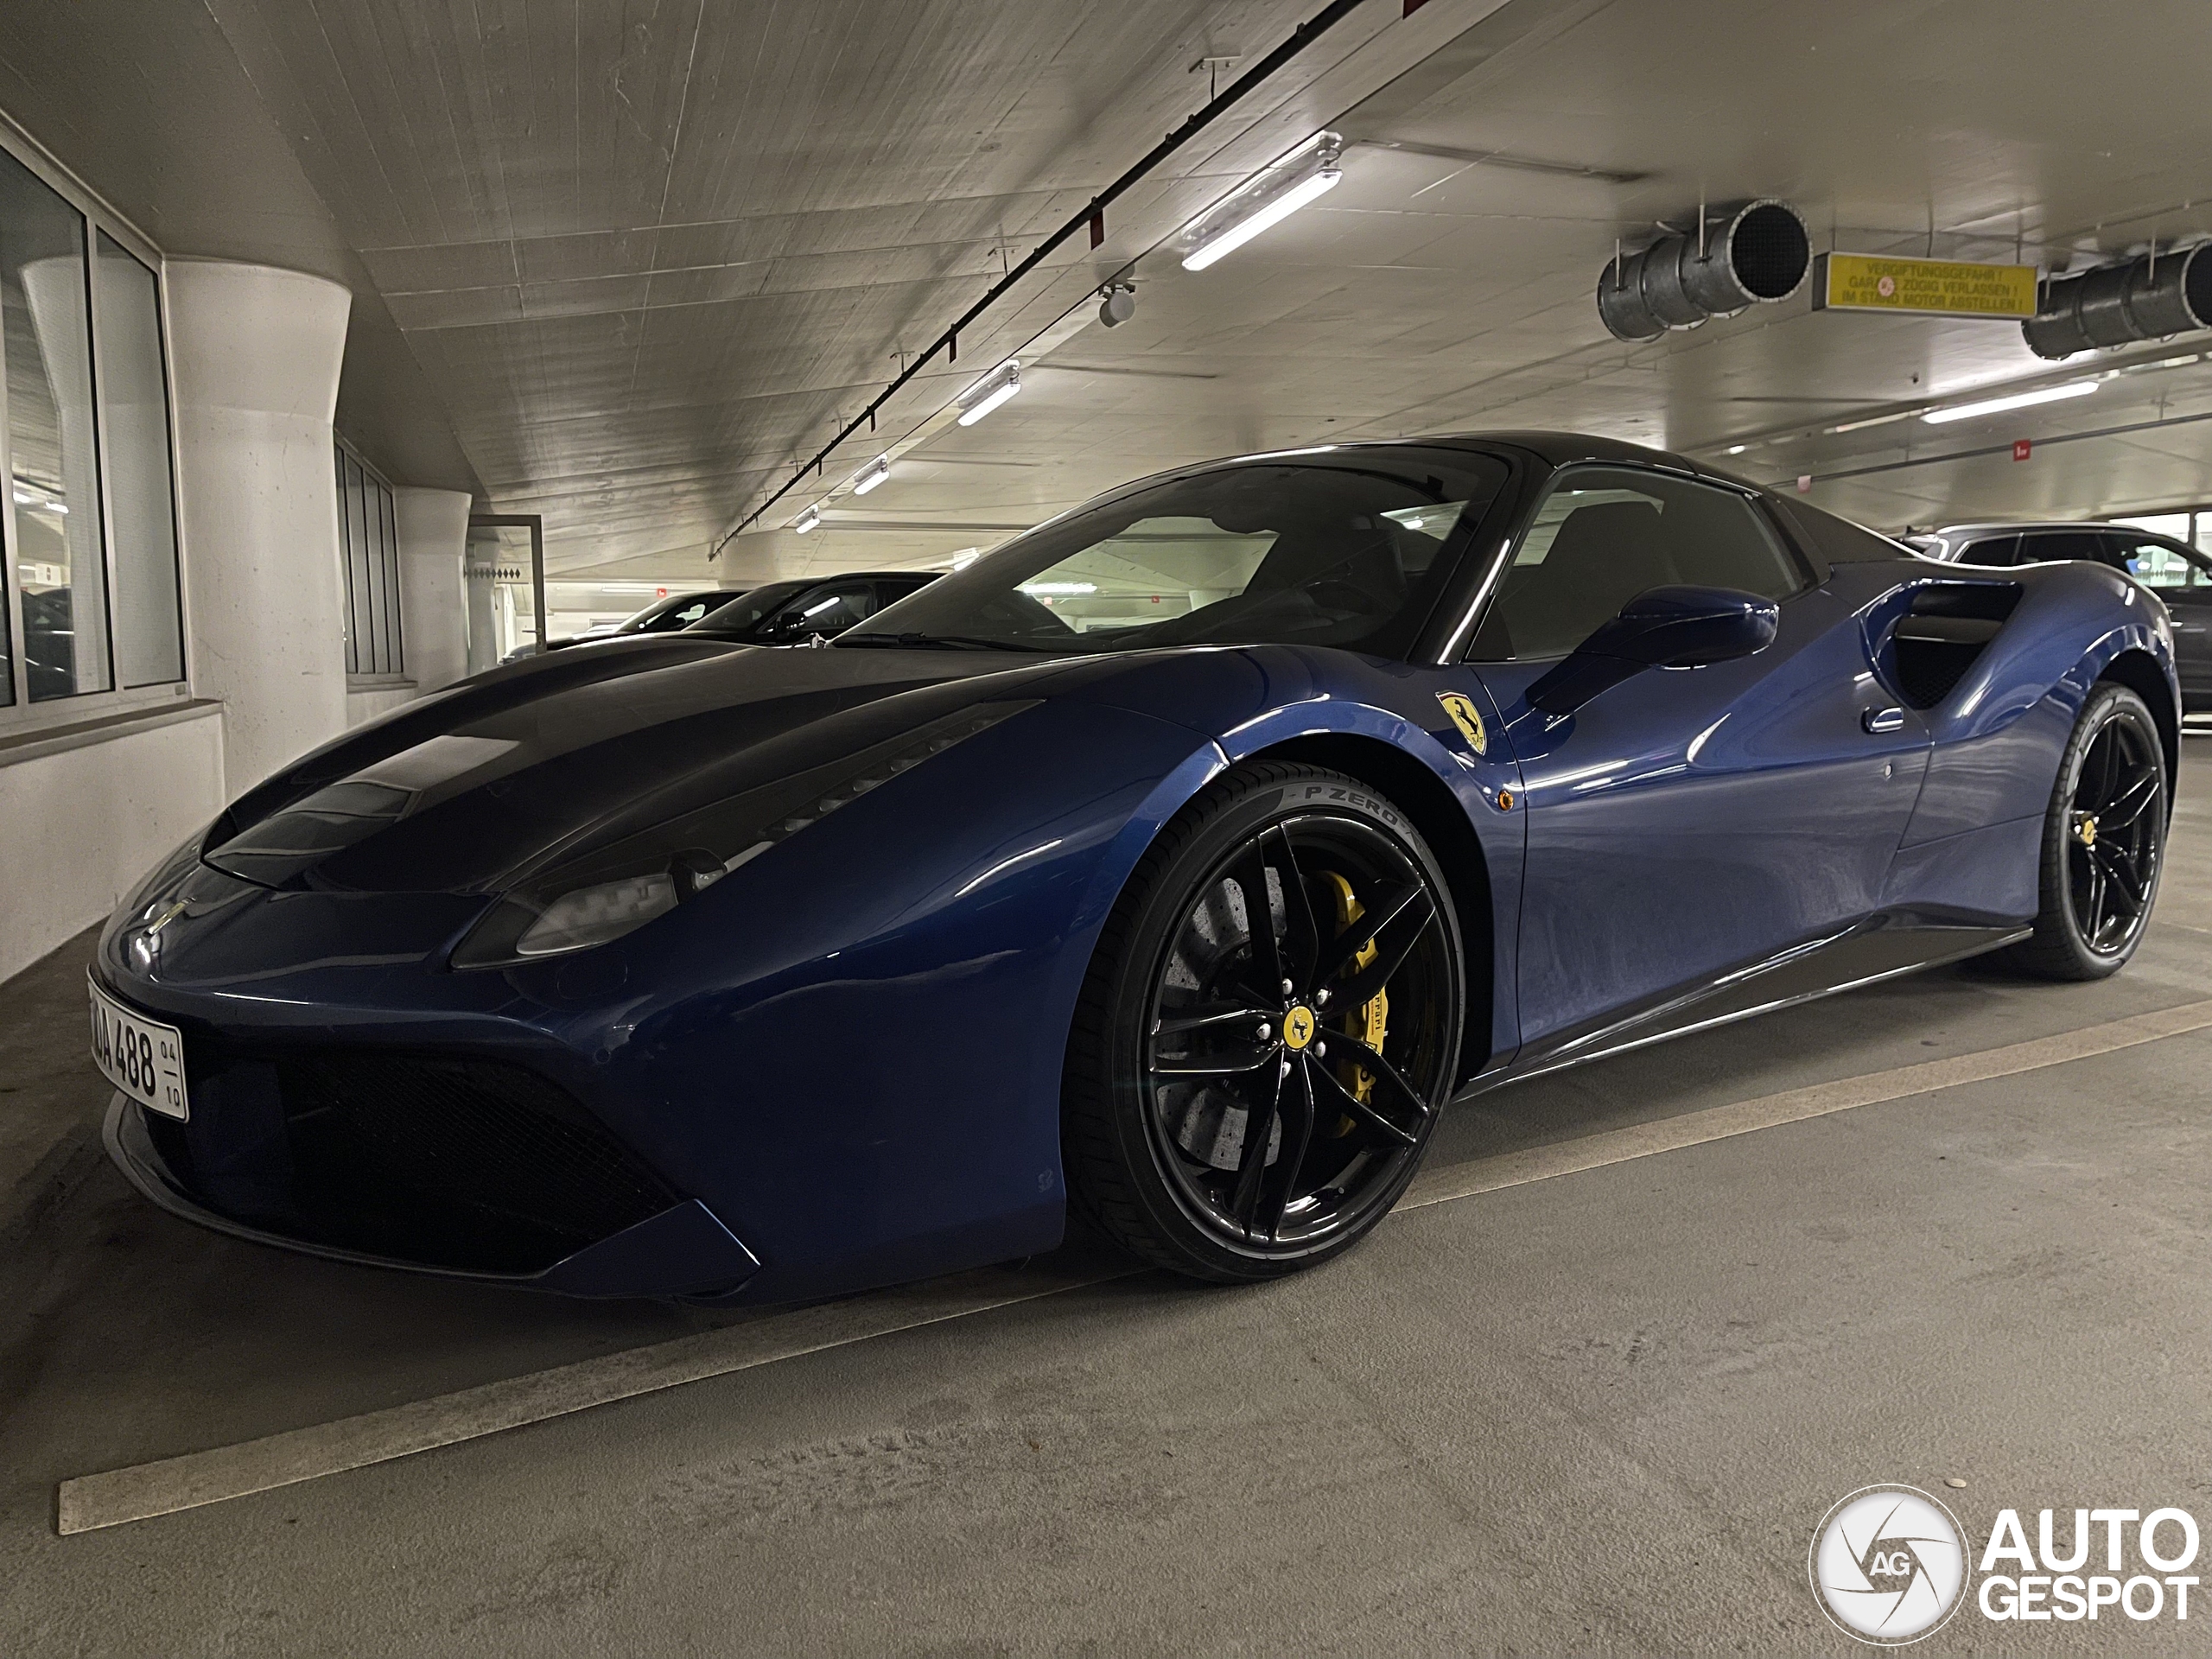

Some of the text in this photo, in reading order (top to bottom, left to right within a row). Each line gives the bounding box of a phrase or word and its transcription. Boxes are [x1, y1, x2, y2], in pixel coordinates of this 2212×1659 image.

[1849, 275, 1897, 291] GARA
[1943, 281, 2010, 296] VERLASSEN
[1842, 289, 1856, 302] IM
[1904, 293, 1945, 308] MOTOR
[1949, 296, 2016, 310] ABSTELLEN
[1305, 786, 1399, 825] P ZERO
[116, 1019, 156, 1097] 488
[161, 1040, 176, 1062] 04
[166, 1085, 180, 1108] 10
